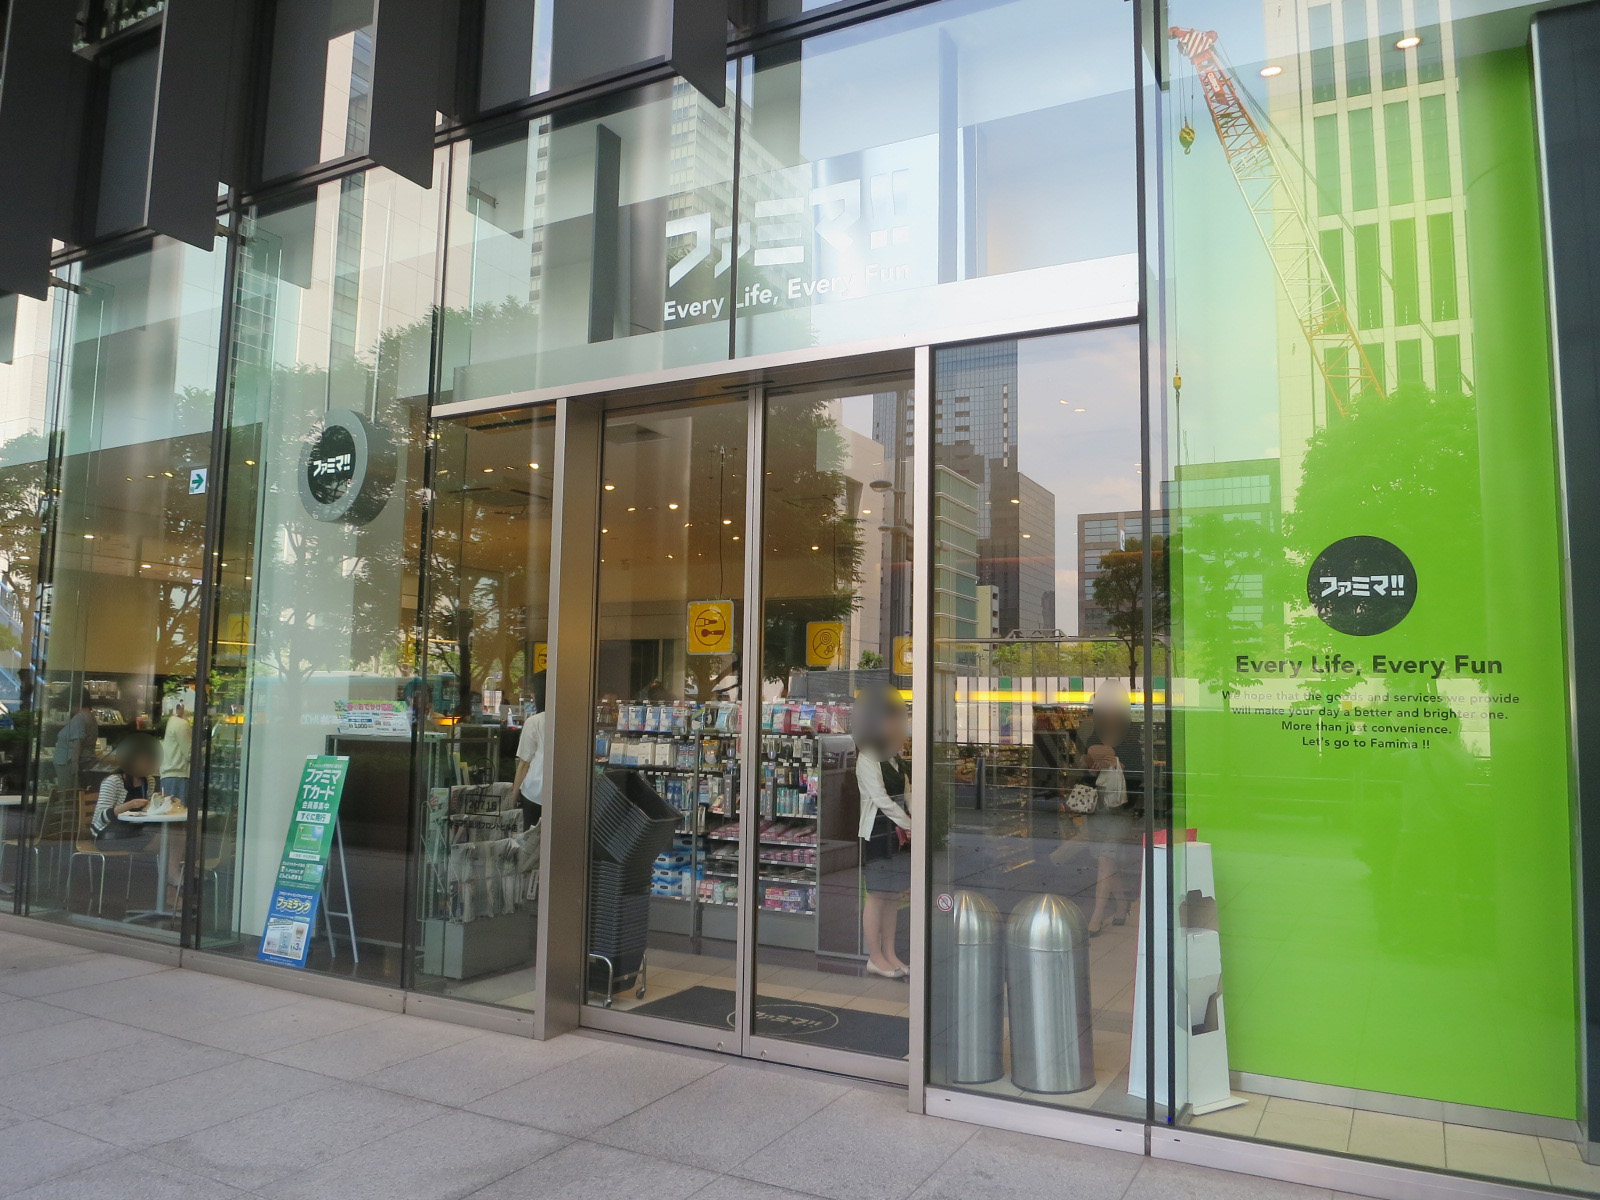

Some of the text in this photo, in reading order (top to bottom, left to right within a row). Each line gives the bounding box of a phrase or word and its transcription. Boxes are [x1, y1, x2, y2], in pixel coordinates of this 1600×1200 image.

[664, 297, 725, 321] Every
[788, 273, 852, 299] Every
[864, 264, 909, 286] Fun
[313, 453, 351, 477] ファミマ!!
[1319, 574, 1405, 597] ファミマ!!
[1236, 654, 1503, 679] Every Life, Every Fun
[1222, 690, 1520, 706] We hope that the goods and services we provide
[1232, 706, 1251, 715] will
[1254, 706, 1285, 716] make
[1289, 708, 1314, 718] your
[1319, 707, 1340, 719] day
[1354, 707, 1392, 717] better
[1396, 708, 1419, 718] and
[1423, 708, 1475, 720] brighter
[1481, 711, 1508, 720] one.
[1281, 721, 1452, 734] More than just convenience.
[1303, 736, 1430, 749] Let's go to Famima !!
[305, 768, 341, 784] ファミマ
[303, 784, 336, 800] Tカード
[276, 896, 311, 914] ファミランク
